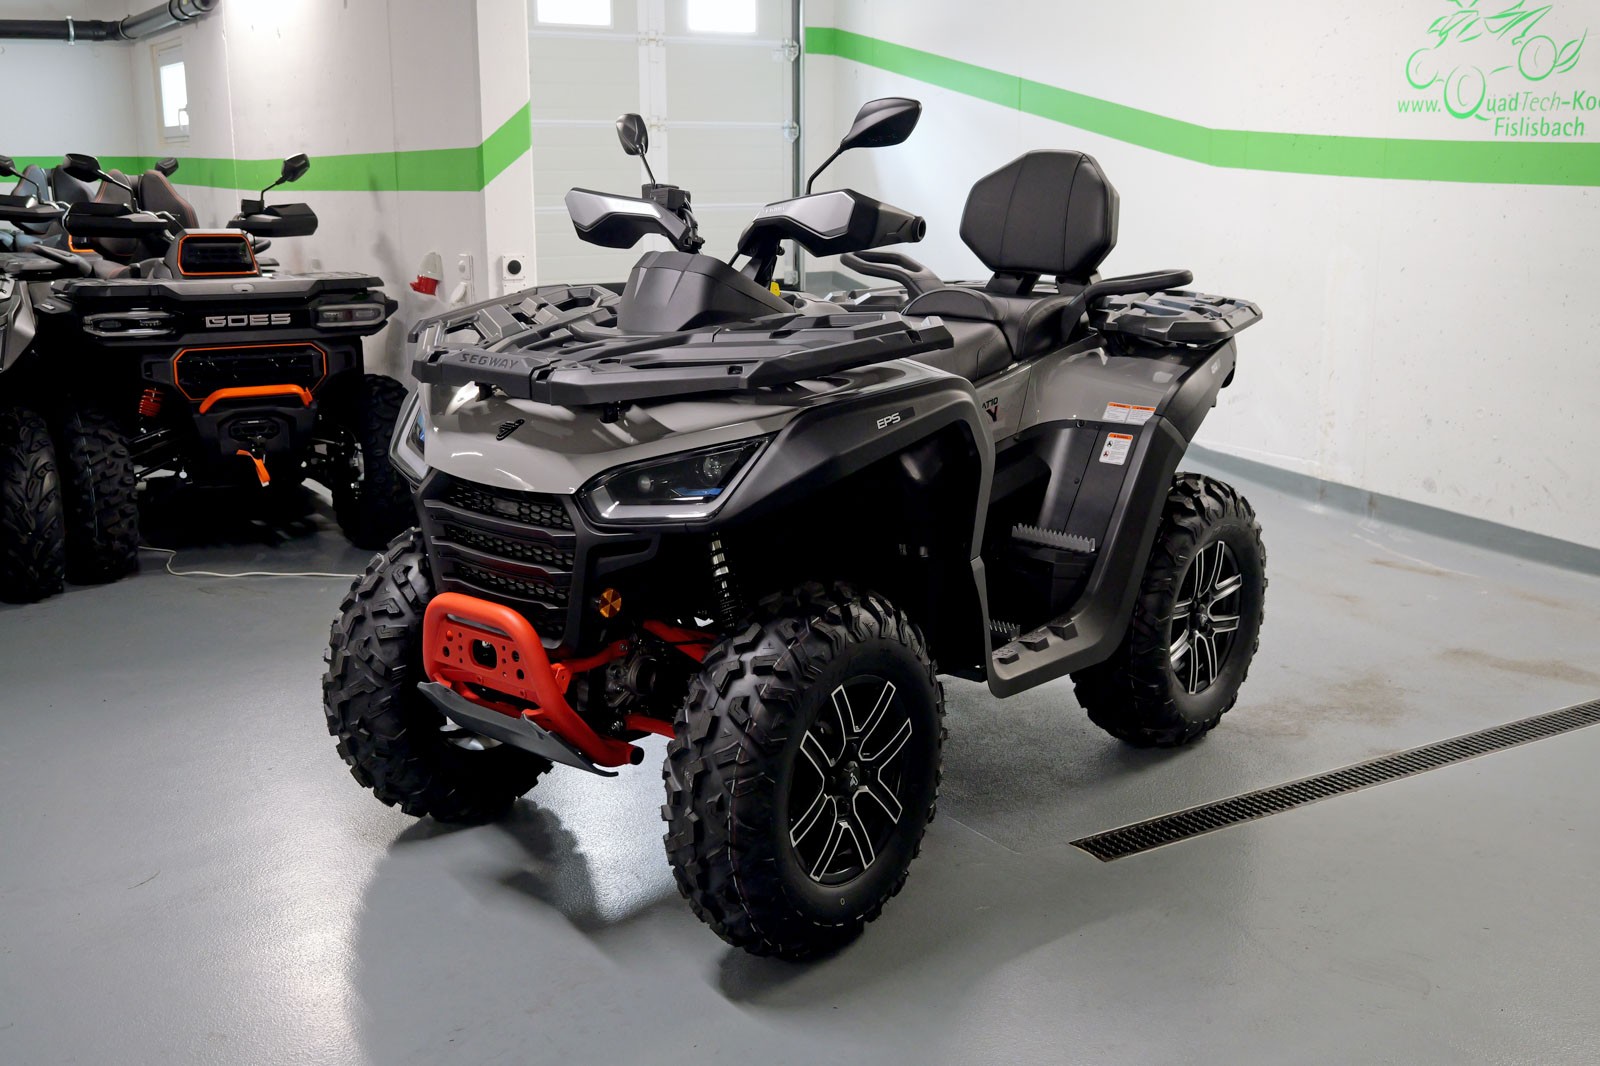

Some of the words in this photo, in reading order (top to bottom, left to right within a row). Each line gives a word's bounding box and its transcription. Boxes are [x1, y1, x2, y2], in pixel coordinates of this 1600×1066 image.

[1397, 66, 1600, 120] www.QuadTech-Ko
[1494, 116, 1585, 137] Fislisbach
[205, 313, 291, 328] GOES
[460, 353, 519, 369] SEGWAY
[876, 412, 901, 430] EPS
